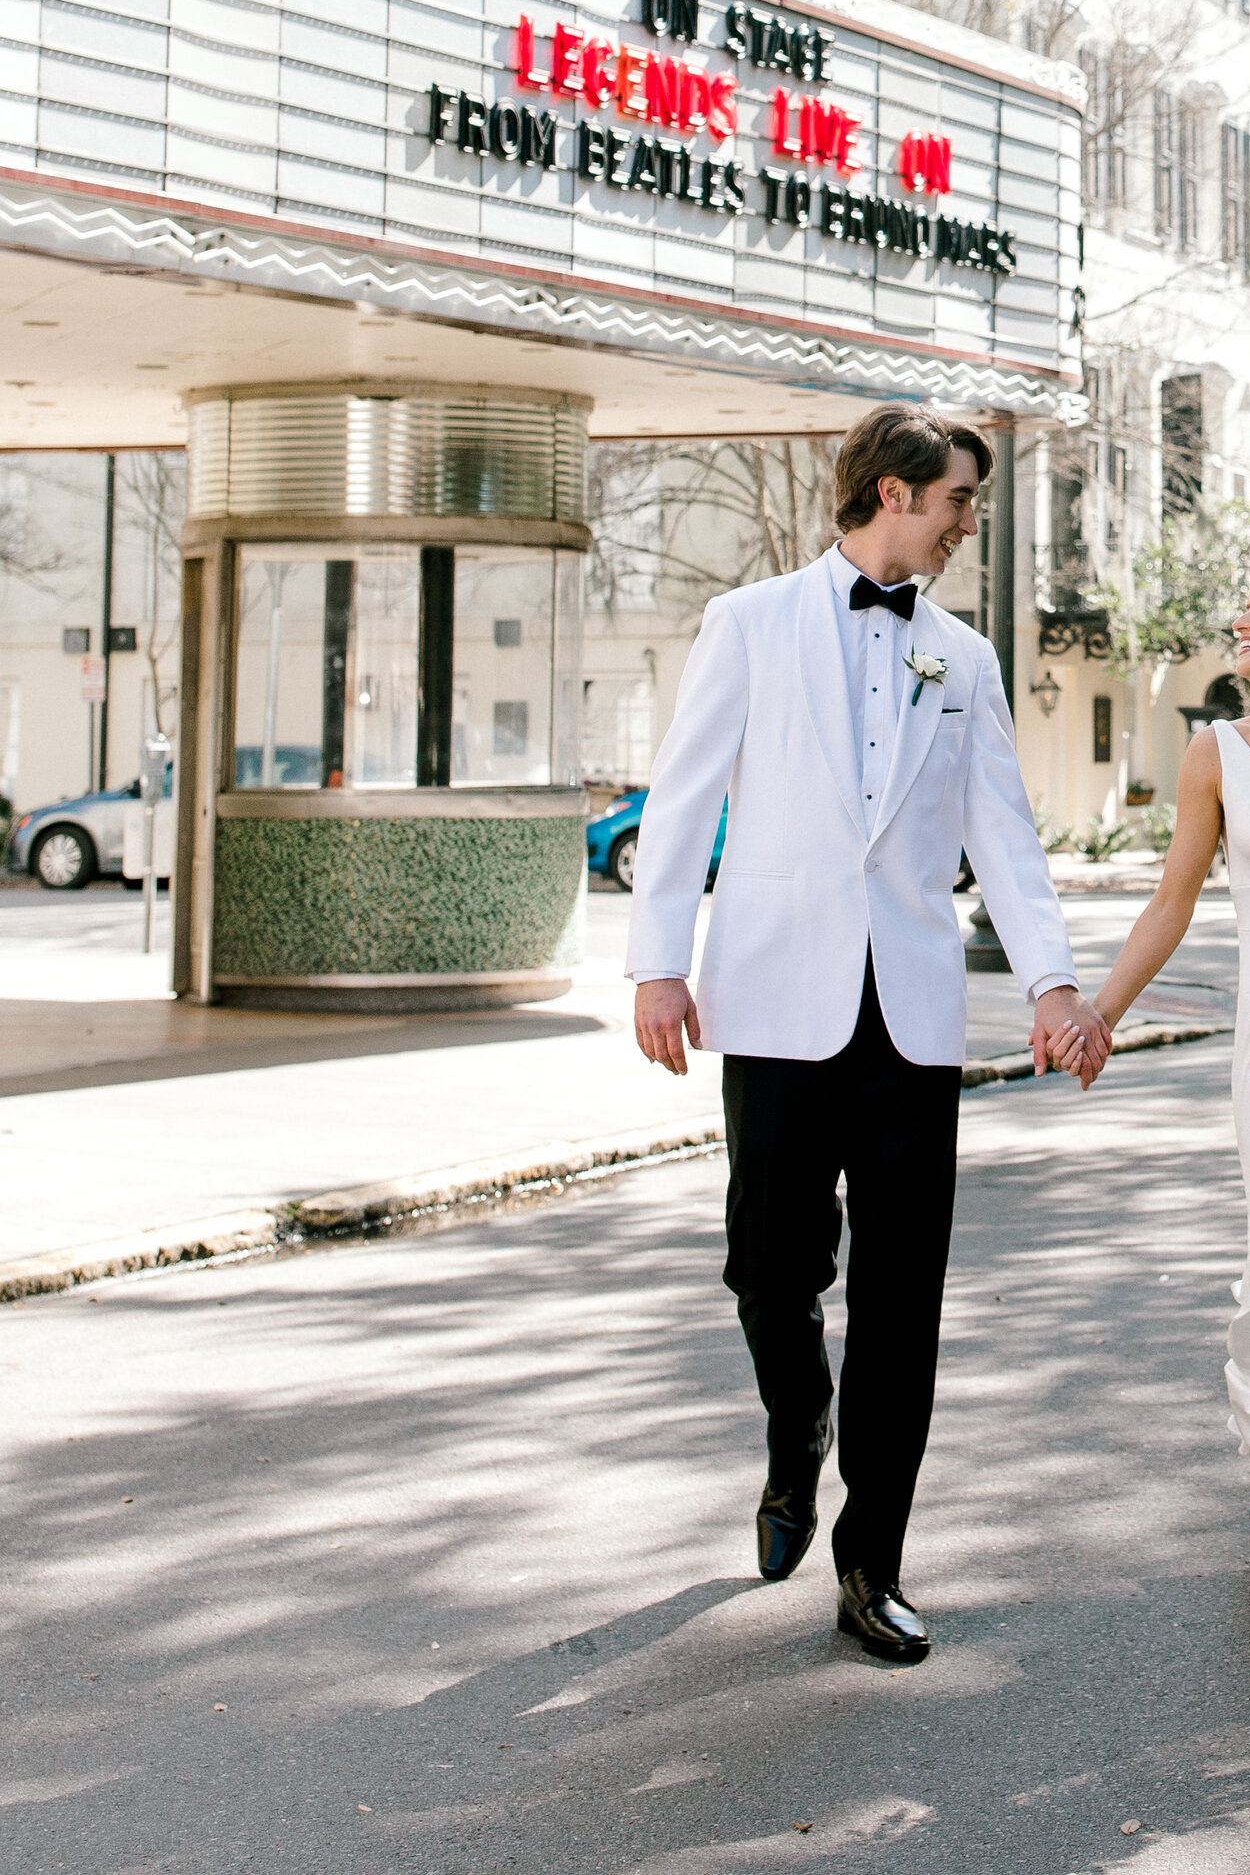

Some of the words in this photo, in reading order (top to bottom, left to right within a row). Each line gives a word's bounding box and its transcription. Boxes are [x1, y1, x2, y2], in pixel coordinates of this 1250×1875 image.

[515, 13, 739, 142] LEGENDS
[770, 86, 862, 175] LIVE
[900, 130, 952, 194] ON
[725, 1, 835, 83] STAGE
[430, 83, 562, 171] FROM
[580, 117, 745, 215] BEATLES
[761, 164, 811, 229] TO
[822, 182, 931, 258] BRUNO
[936, 213, 1018, 277] MARS
